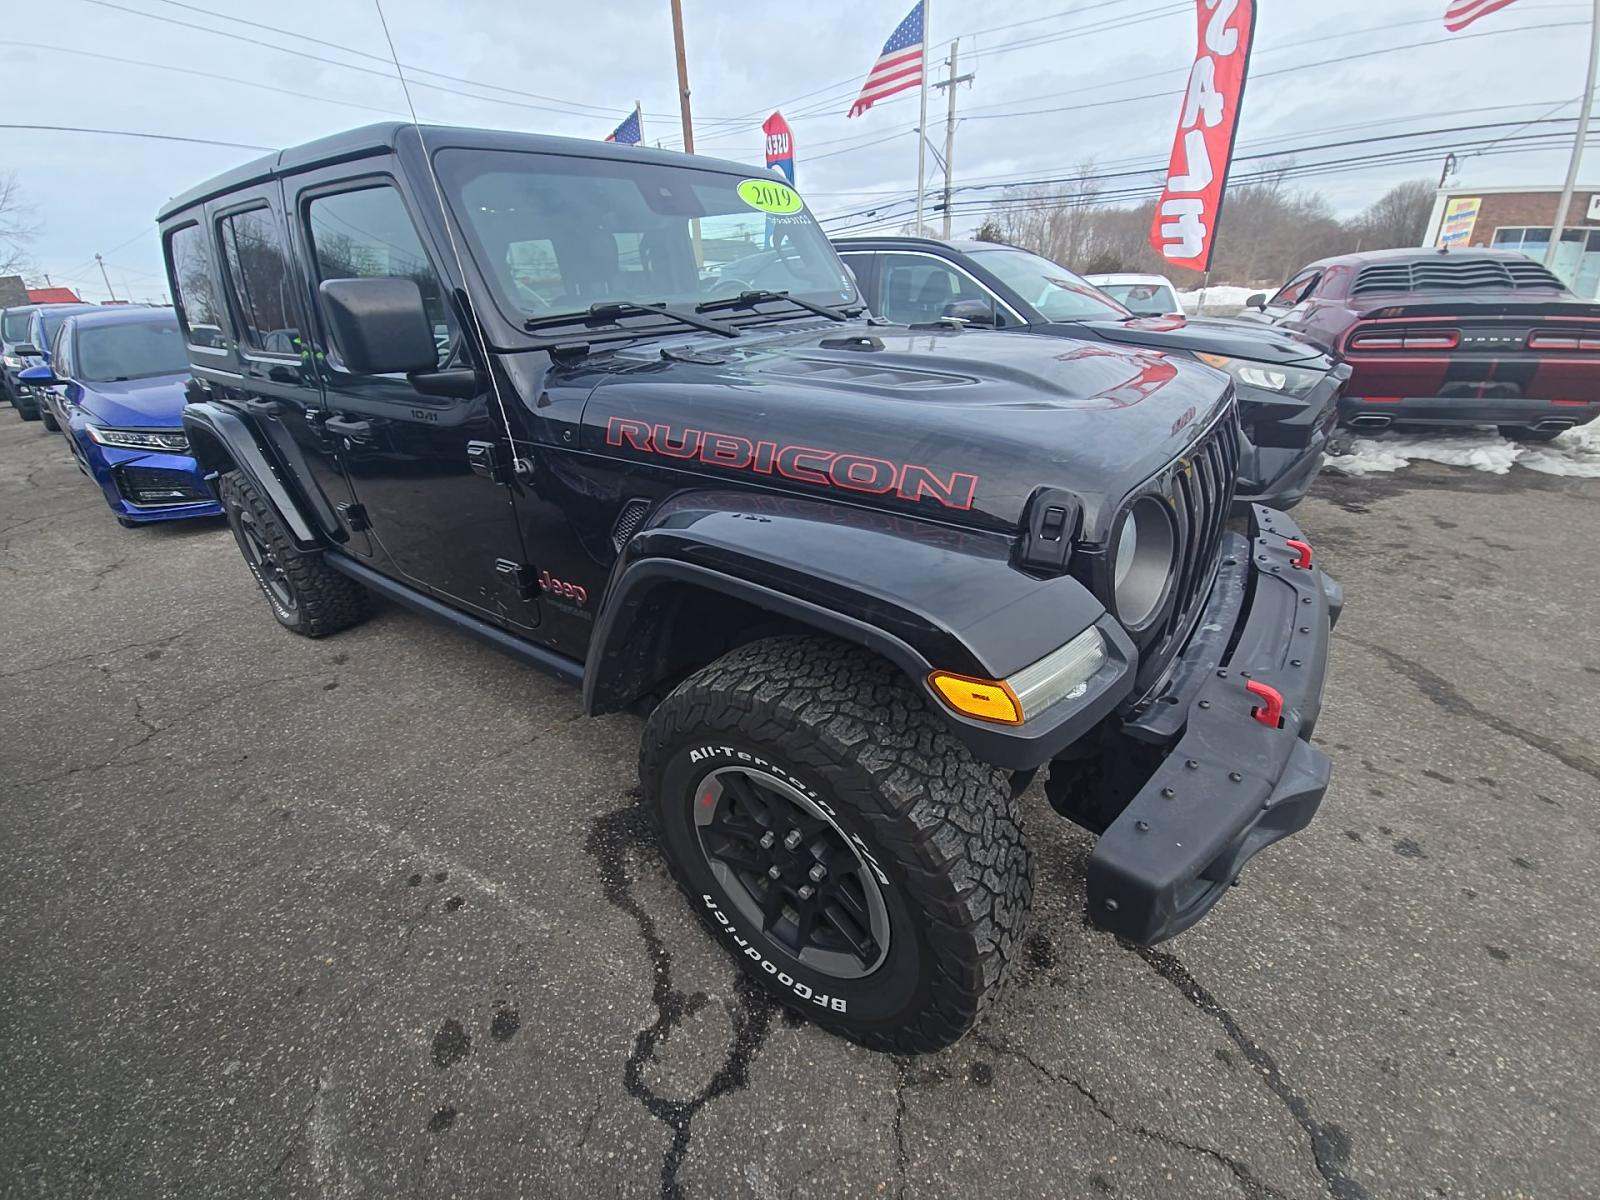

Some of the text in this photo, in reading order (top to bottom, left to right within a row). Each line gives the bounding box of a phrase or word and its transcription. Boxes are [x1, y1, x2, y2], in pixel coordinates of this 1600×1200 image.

[751, 186, 792, 207] 2019
[606, 416, 979, 511] RUBICON
[538, 570, 588, 607] Jeep
[688, 745, 836, 817] All-Terrain
[702, 894, 848, 1014] BFGoodrich
